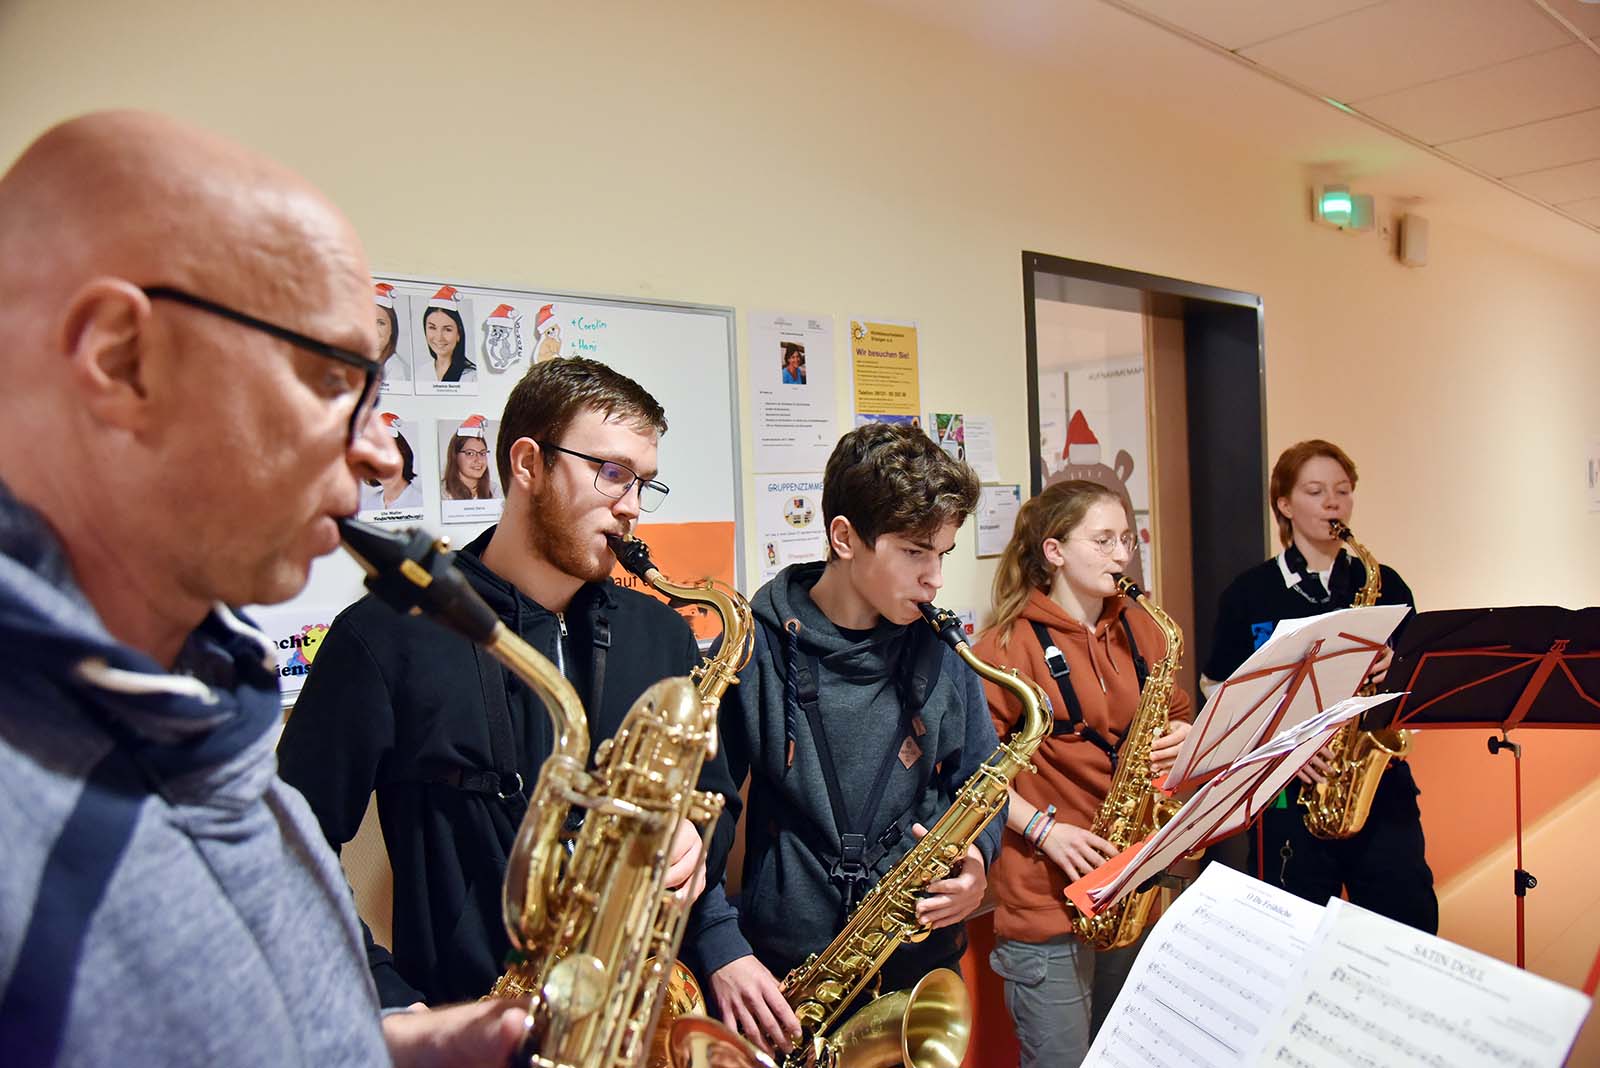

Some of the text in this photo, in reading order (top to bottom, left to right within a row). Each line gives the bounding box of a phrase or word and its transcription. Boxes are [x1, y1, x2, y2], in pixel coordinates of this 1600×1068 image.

[856, 347, 867, 356] Wir
[868, 349, 898, 359] besuchen
[1413, 943, 1449, 967] SATIN
[1450, 958, 1486, 982] DOLL
